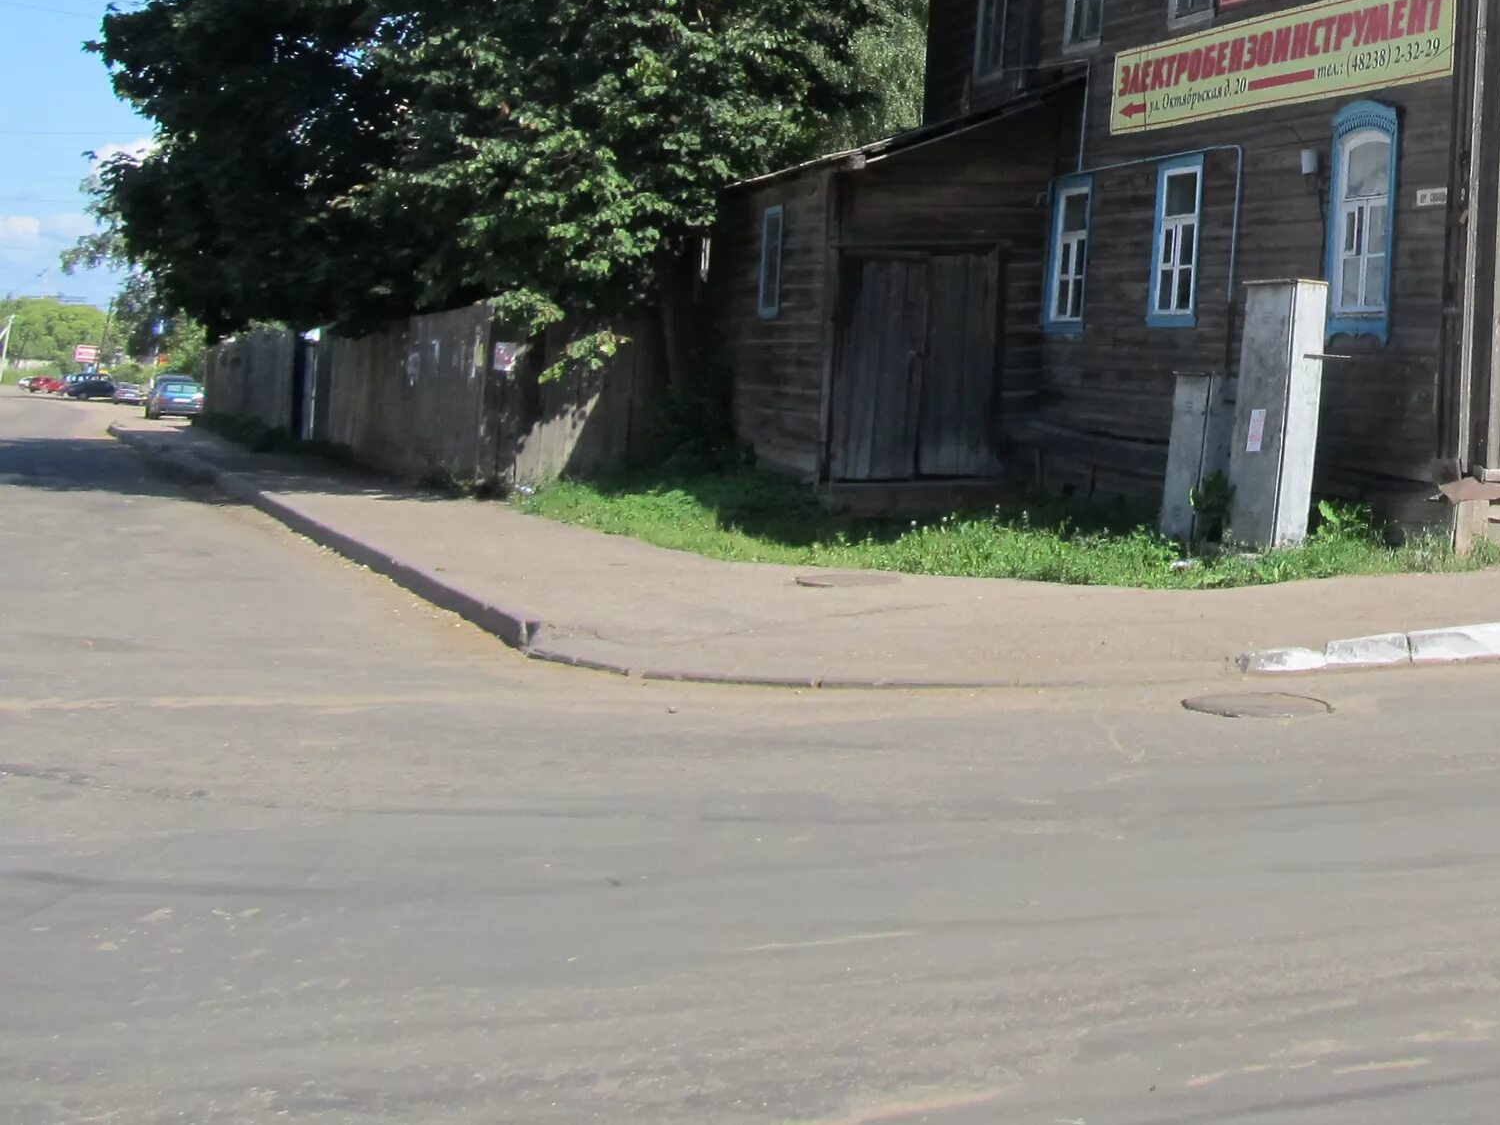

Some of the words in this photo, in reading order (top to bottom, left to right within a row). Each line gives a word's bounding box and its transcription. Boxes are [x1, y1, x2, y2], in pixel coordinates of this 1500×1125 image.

[1346, 43, 1391, 78] (48238)
[1394, 37, 1441, 65] 2-32-29
[1162, 86, 1222, 111] Октябрьская
[1233, 76, 1247, 95] 20
